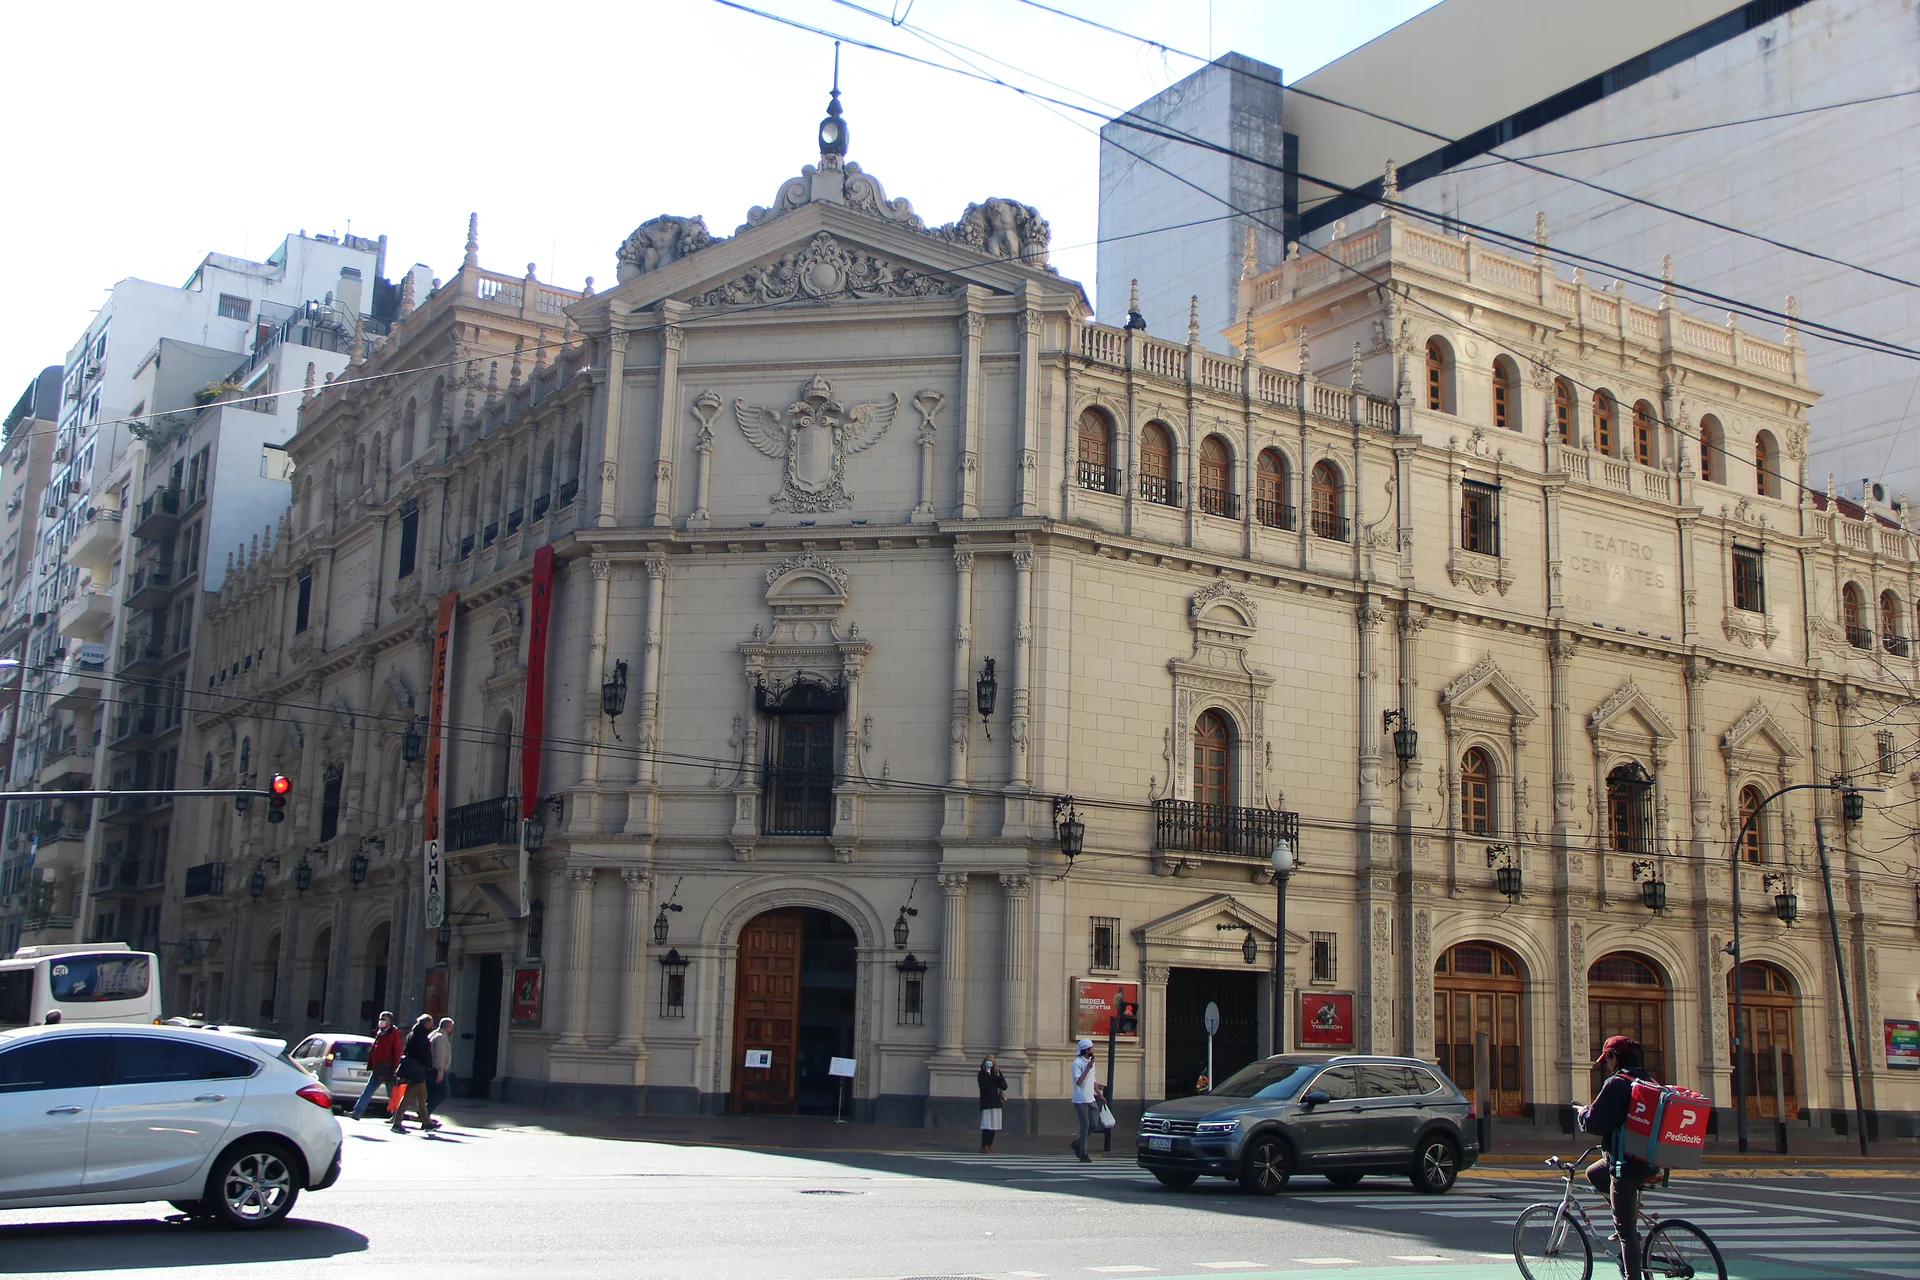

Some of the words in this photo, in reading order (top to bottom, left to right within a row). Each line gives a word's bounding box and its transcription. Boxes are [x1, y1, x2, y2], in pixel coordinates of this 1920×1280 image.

[1582, 531, 1653, 560] TEATRO
[1570, 556, 1664, 588] CERVANTES
[434, 630, 449, 737] TEATRO
[432, 753, 440, 790] EN
[428, 805, 439, 894] LUCHA
[1627, 1112, 1650, 1125] PedidosYa
[1665, 1132, 1702, 1144] PedidosYa
